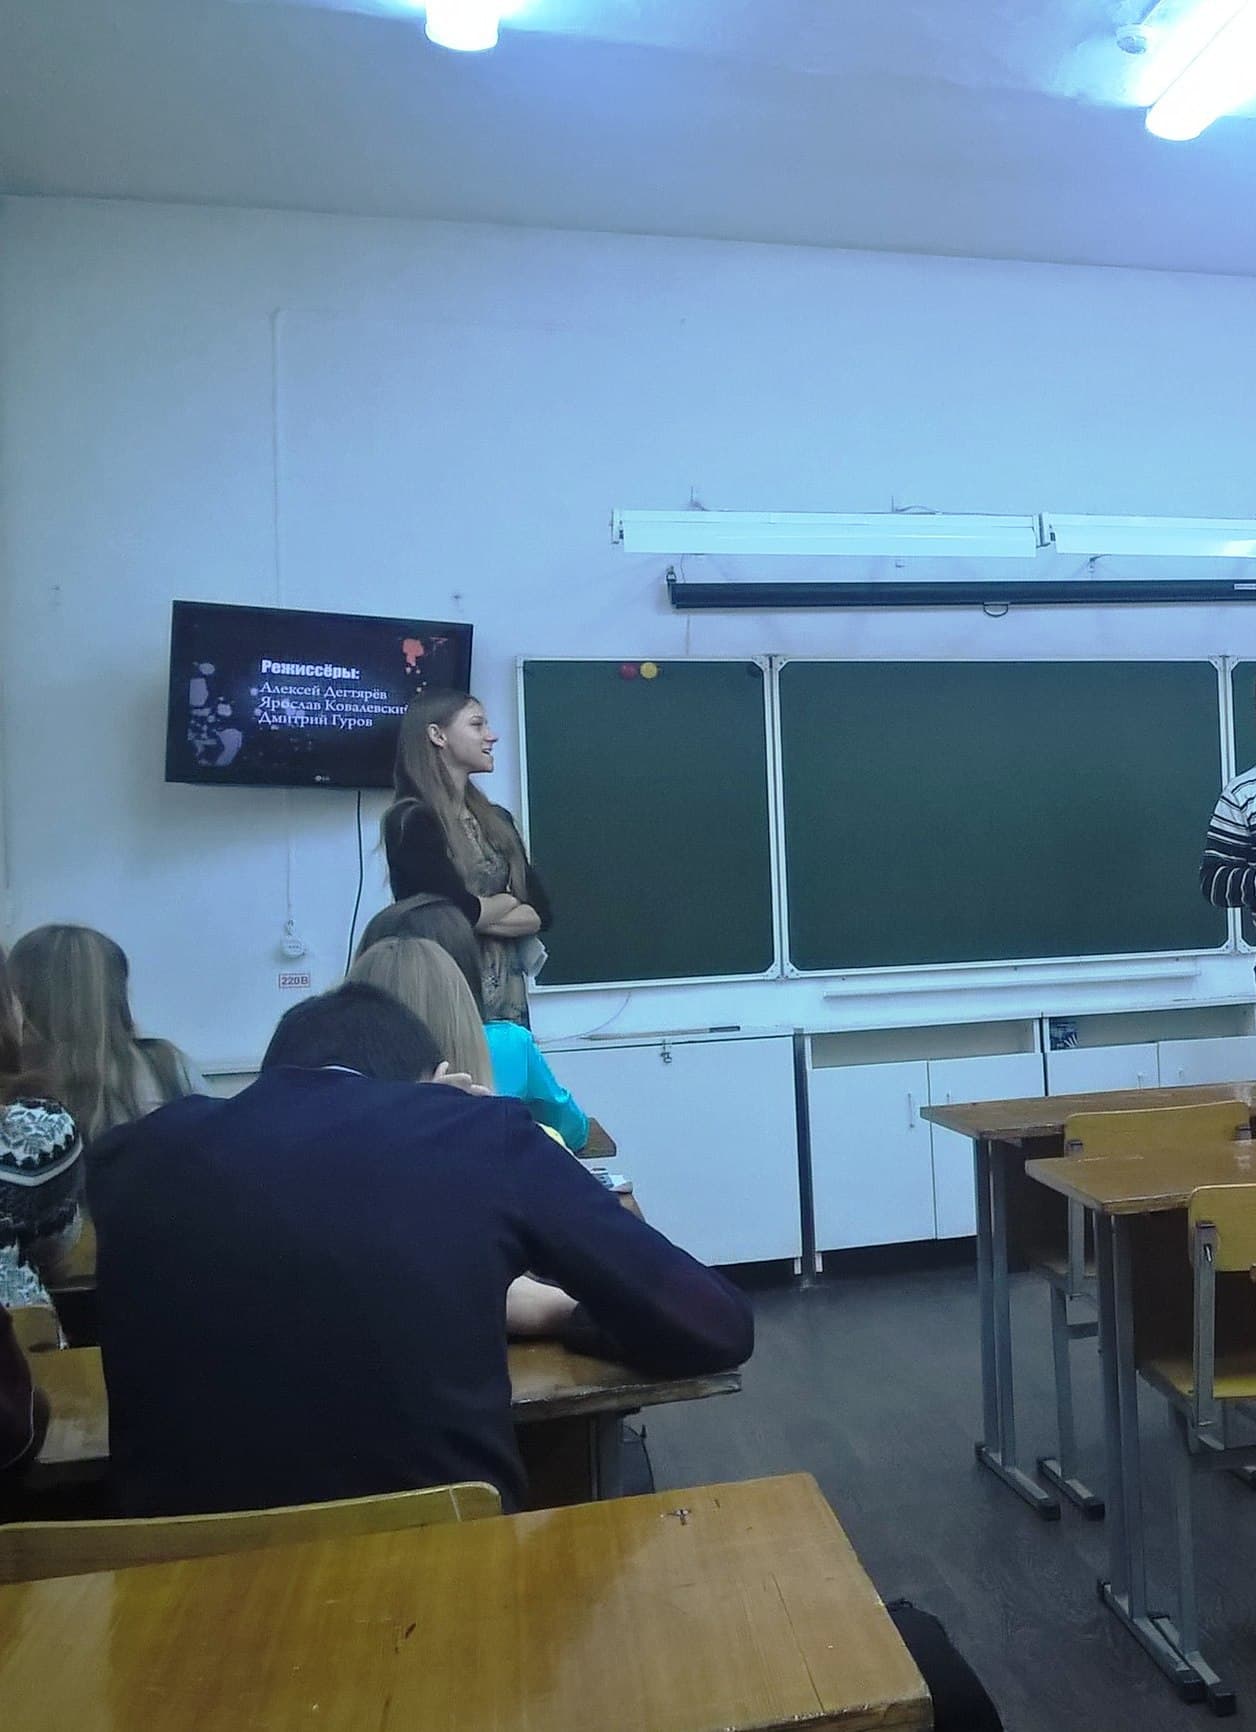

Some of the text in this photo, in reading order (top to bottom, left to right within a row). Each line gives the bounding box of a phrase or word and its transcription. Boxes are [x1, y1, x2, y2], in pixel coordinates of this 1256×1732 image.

[261, 659, 361, 680] Режиссёры:
[259, 682, 388, 702] Алексей Дегтярёв
[258, 696, 321, 712] Ярослав
[258, 711, 373, 730] Дмитрий Гуров
